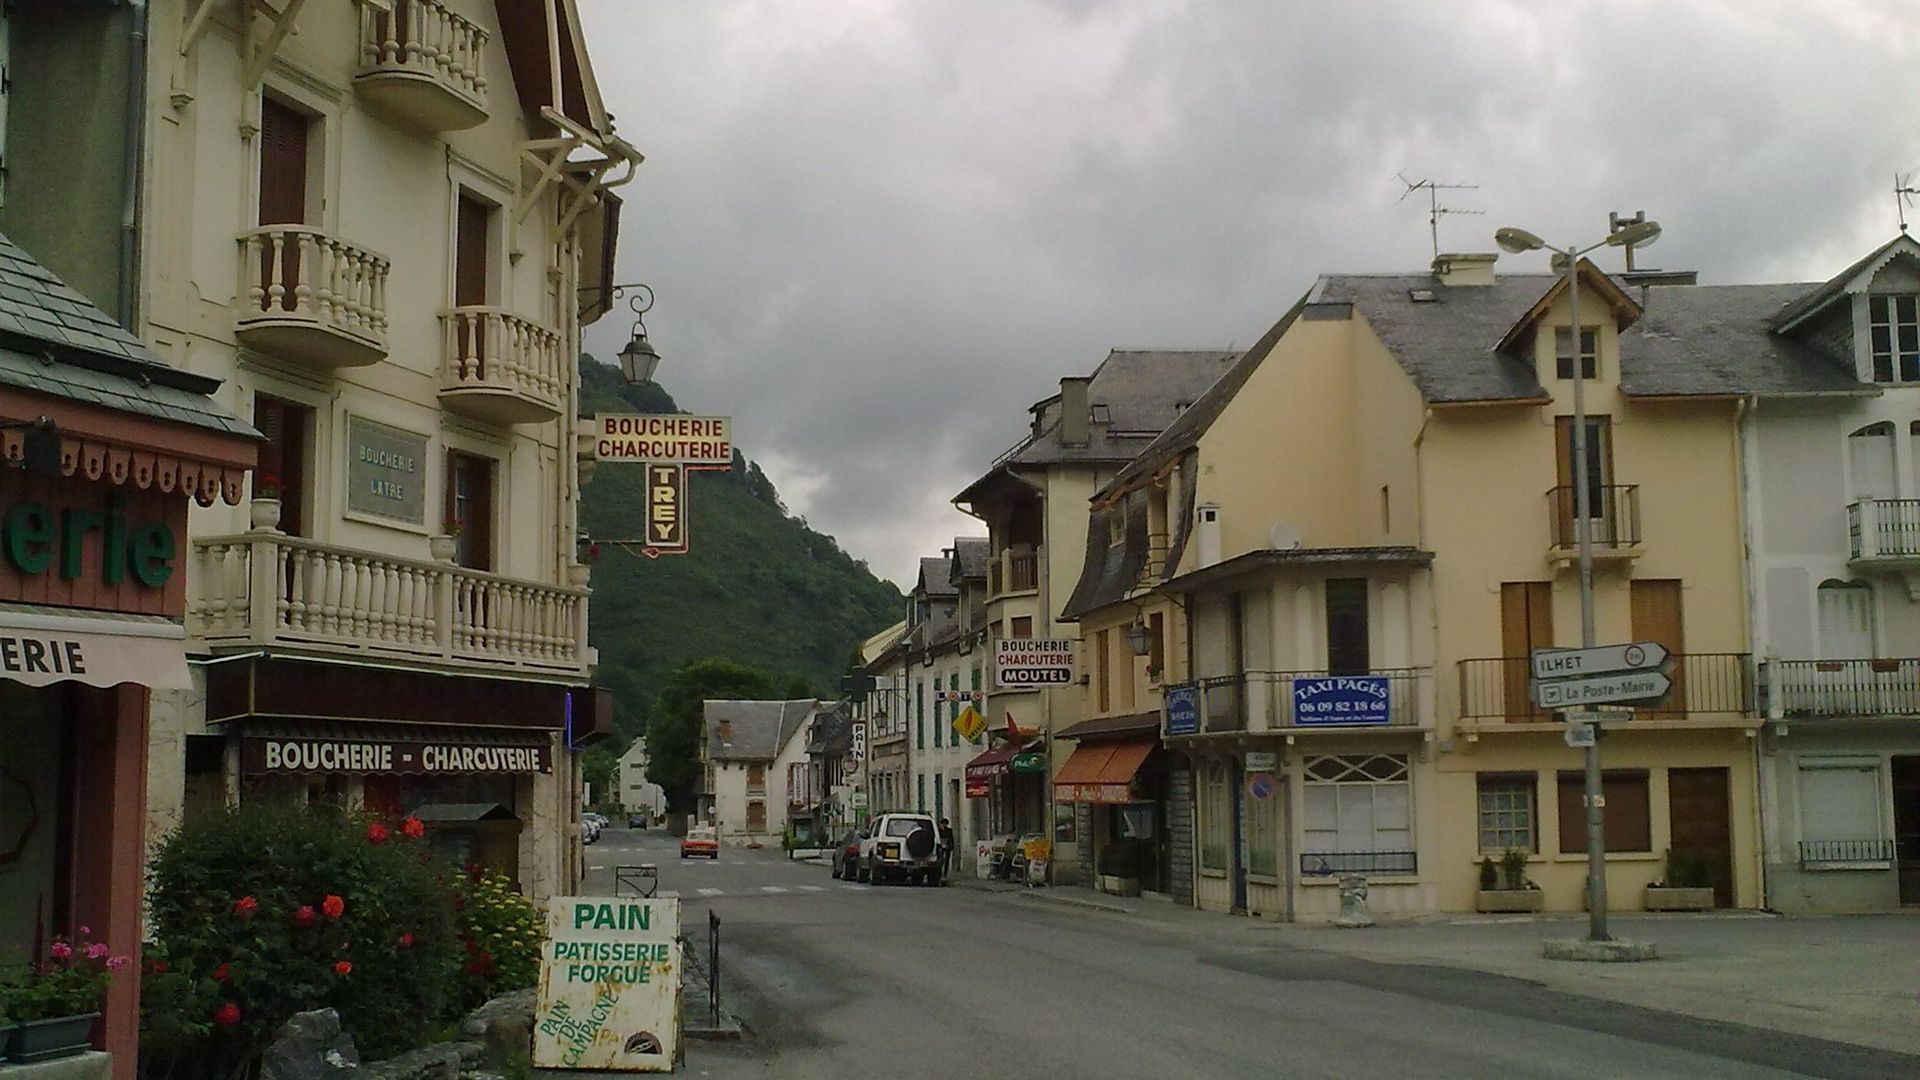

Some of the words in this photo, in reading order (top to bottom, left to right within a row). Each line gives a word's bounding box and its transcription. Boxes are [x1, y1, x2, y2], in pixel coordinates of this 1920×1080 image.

[605, 418, 723, 437] BOUCHERIE
[360, 446, 416, 472] BOUCHERIE
[599, 440, 730, 458] CHARCUTERIE
[653, 468, 676, 539] TREY
[1, 637, 86, 674] ERIE
[1002, 641, 1069, 651] BOUCHERIE
[998, 654, 1073, 665] CHARCUTERIE
[1540, 656, 1582, 672] ILHET
[1005, 670, 1067, 681] MOUTEL
[1296, 680, 1333, 700] TAXI
[1567, 688, 1579, 699] La
[1300, 702, 1315, 713] 06
[1317, 702, 1333, 712] 09
[1335, 702, 1350, 712] 82
[855, 725, 864, 759] PAIN
[266, 742, 392, 770] BOUCHERIE
[423, 746, 540, 770] CHARCUTERIE
[574, 904, 650, 930] PAIN
[554, 942, 669, 962] PATISSERIE
[568, 965, 651, 983] FORGUE
[540, 1000, 571, 1037] PAIN
[558, 1015, 583, 1040] DE
[562, 990, 620, 1068] CAMPAGNE
